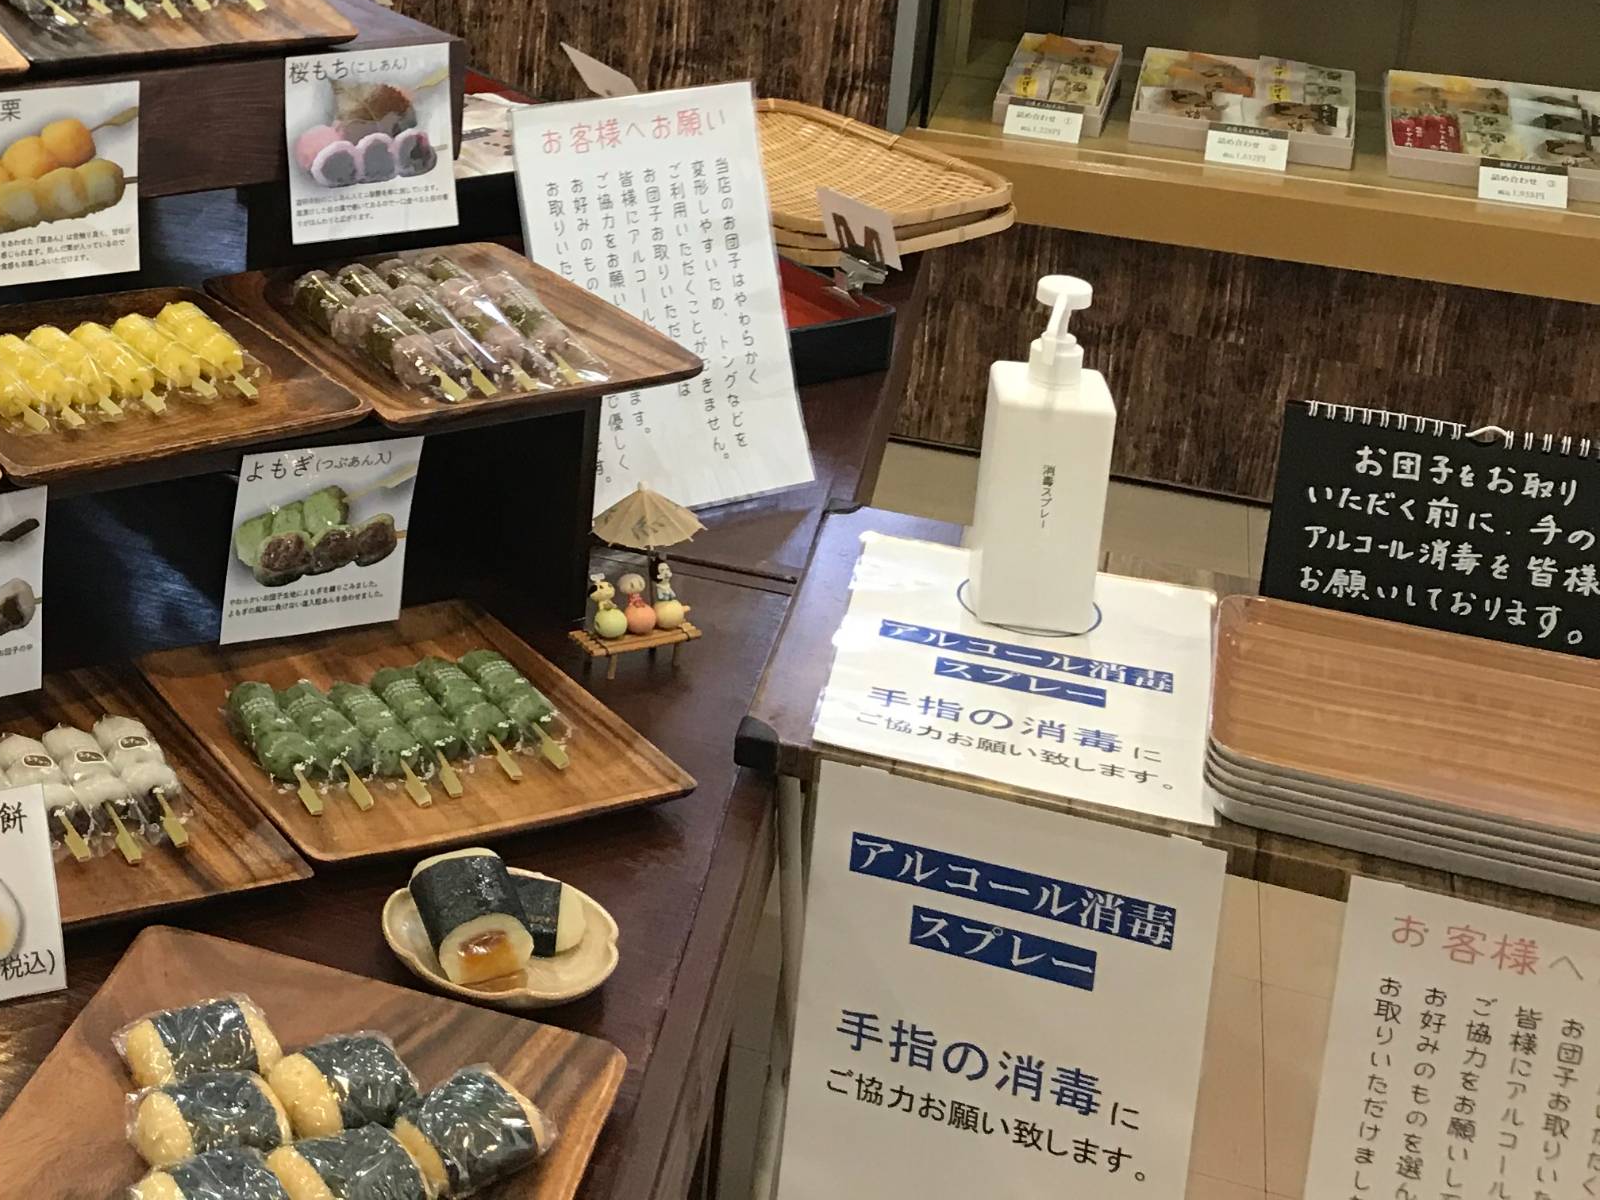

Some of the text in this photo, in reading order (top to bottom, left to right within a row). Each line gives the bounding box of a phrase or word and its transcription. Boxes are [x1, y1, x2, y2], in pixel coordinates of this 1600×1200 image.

[288, 57, 408, 85] 桜もち(こしあん)
[0, 97, 22, 122] 栗
[541, 108, 726, 155] お客様へお願い
[715, 158, 760, 385] 当店のお団子はやわらかく
[246, 451, 393, 483] よもぎ(つぶあん入)
[1040, 464, 1056, 529] 消毒スプレー
[1355, 445, 1578, 506] お団子をお取り
[1303, 525, 1600, 598] アルコール消毒を皆様
[1299, 565, 1584, 645] お願いしております。
[882, 621, 1174, 692] アルコール消毒
[939, 658, 1105, 703] スプレー
[856, 710, 1175, 791] ご協力お願い致します。
[866, 686, 1163, 764] 手指の消毒に
[854, 836, 1173, 947] アルコール消毒
[913, 913, 1094, 975] スプレー
[1391, 914, 1584, 982] お客様へ
[836, 1008, 1140, 1131] 手指の消毒に
[1349, 977, 1403, 1200] お取りいただけまし
[1441, 997, 1499, 1200] ご協力をお願いし
[1488, 1005, 1543, 1200] 皆様にアルコール
[826, 1067, 1147, 1183] ご協力お願い致します。
